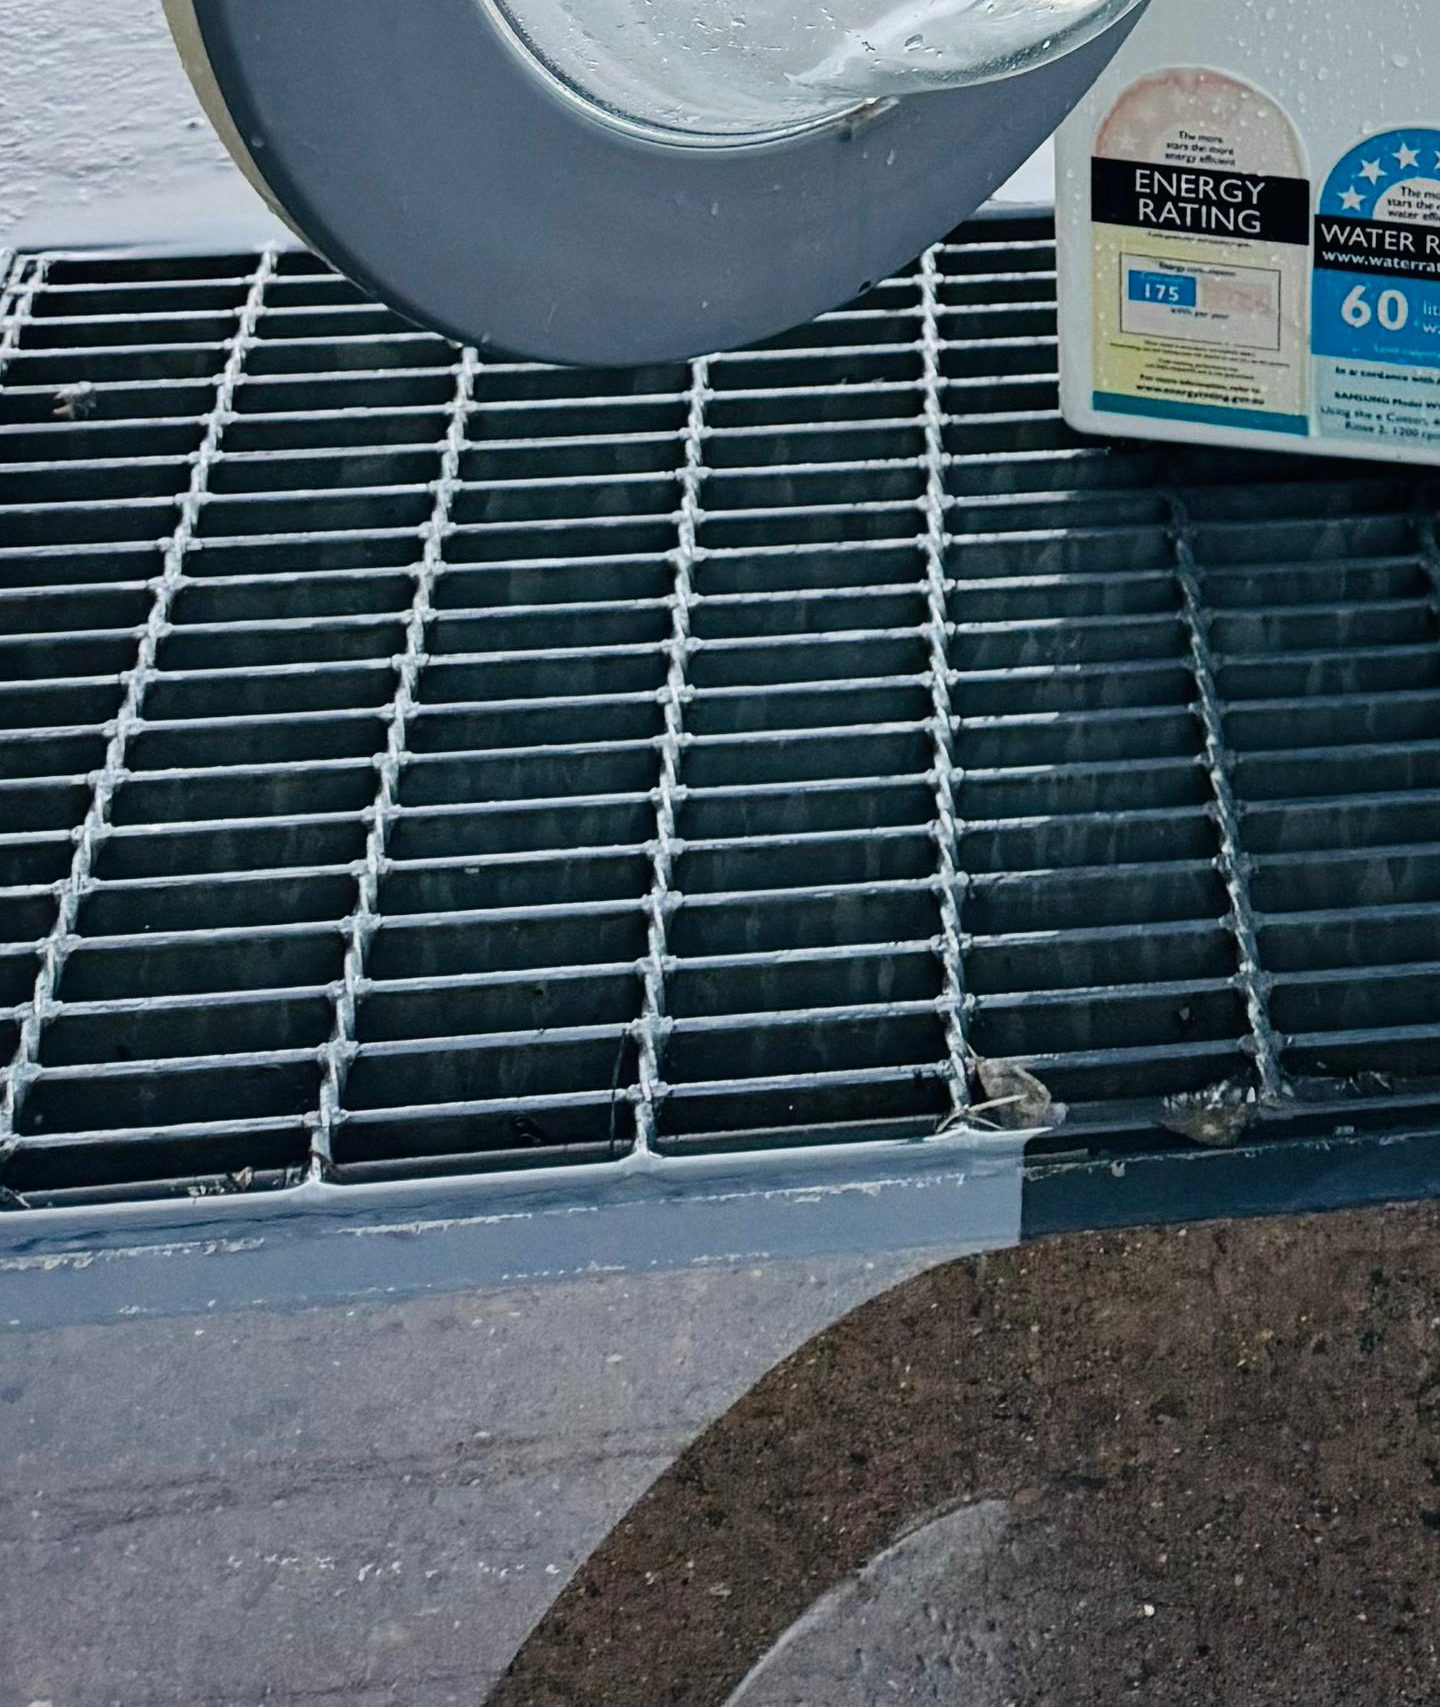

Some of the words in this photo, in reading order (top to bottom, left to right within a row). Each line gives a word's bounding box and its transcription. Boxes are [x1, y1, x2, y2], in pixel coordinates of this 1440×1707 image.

[1179, 130, 1196, 141] The
[1166, 141, 1189, 152] stars
[1209, 146, 1234, 156] more
[1165, 152, 1196, 164] energy
[1199, 155, 1236, 167] efficient
[1135, 169, 1265, 205] ENERGY
[1400, 186, 1421, 198] The
[1387, 198, 1412, 209] stars
[1416, 200, 1434, 211] the
[1139, 198, 1261, 234] RATING
[1388, 210, 1418, 220] water
[1321, 223, 1416, 253] WATER
[1143, 283, 1180, 303] 175
[1340, 284, 1409, 331] 60
